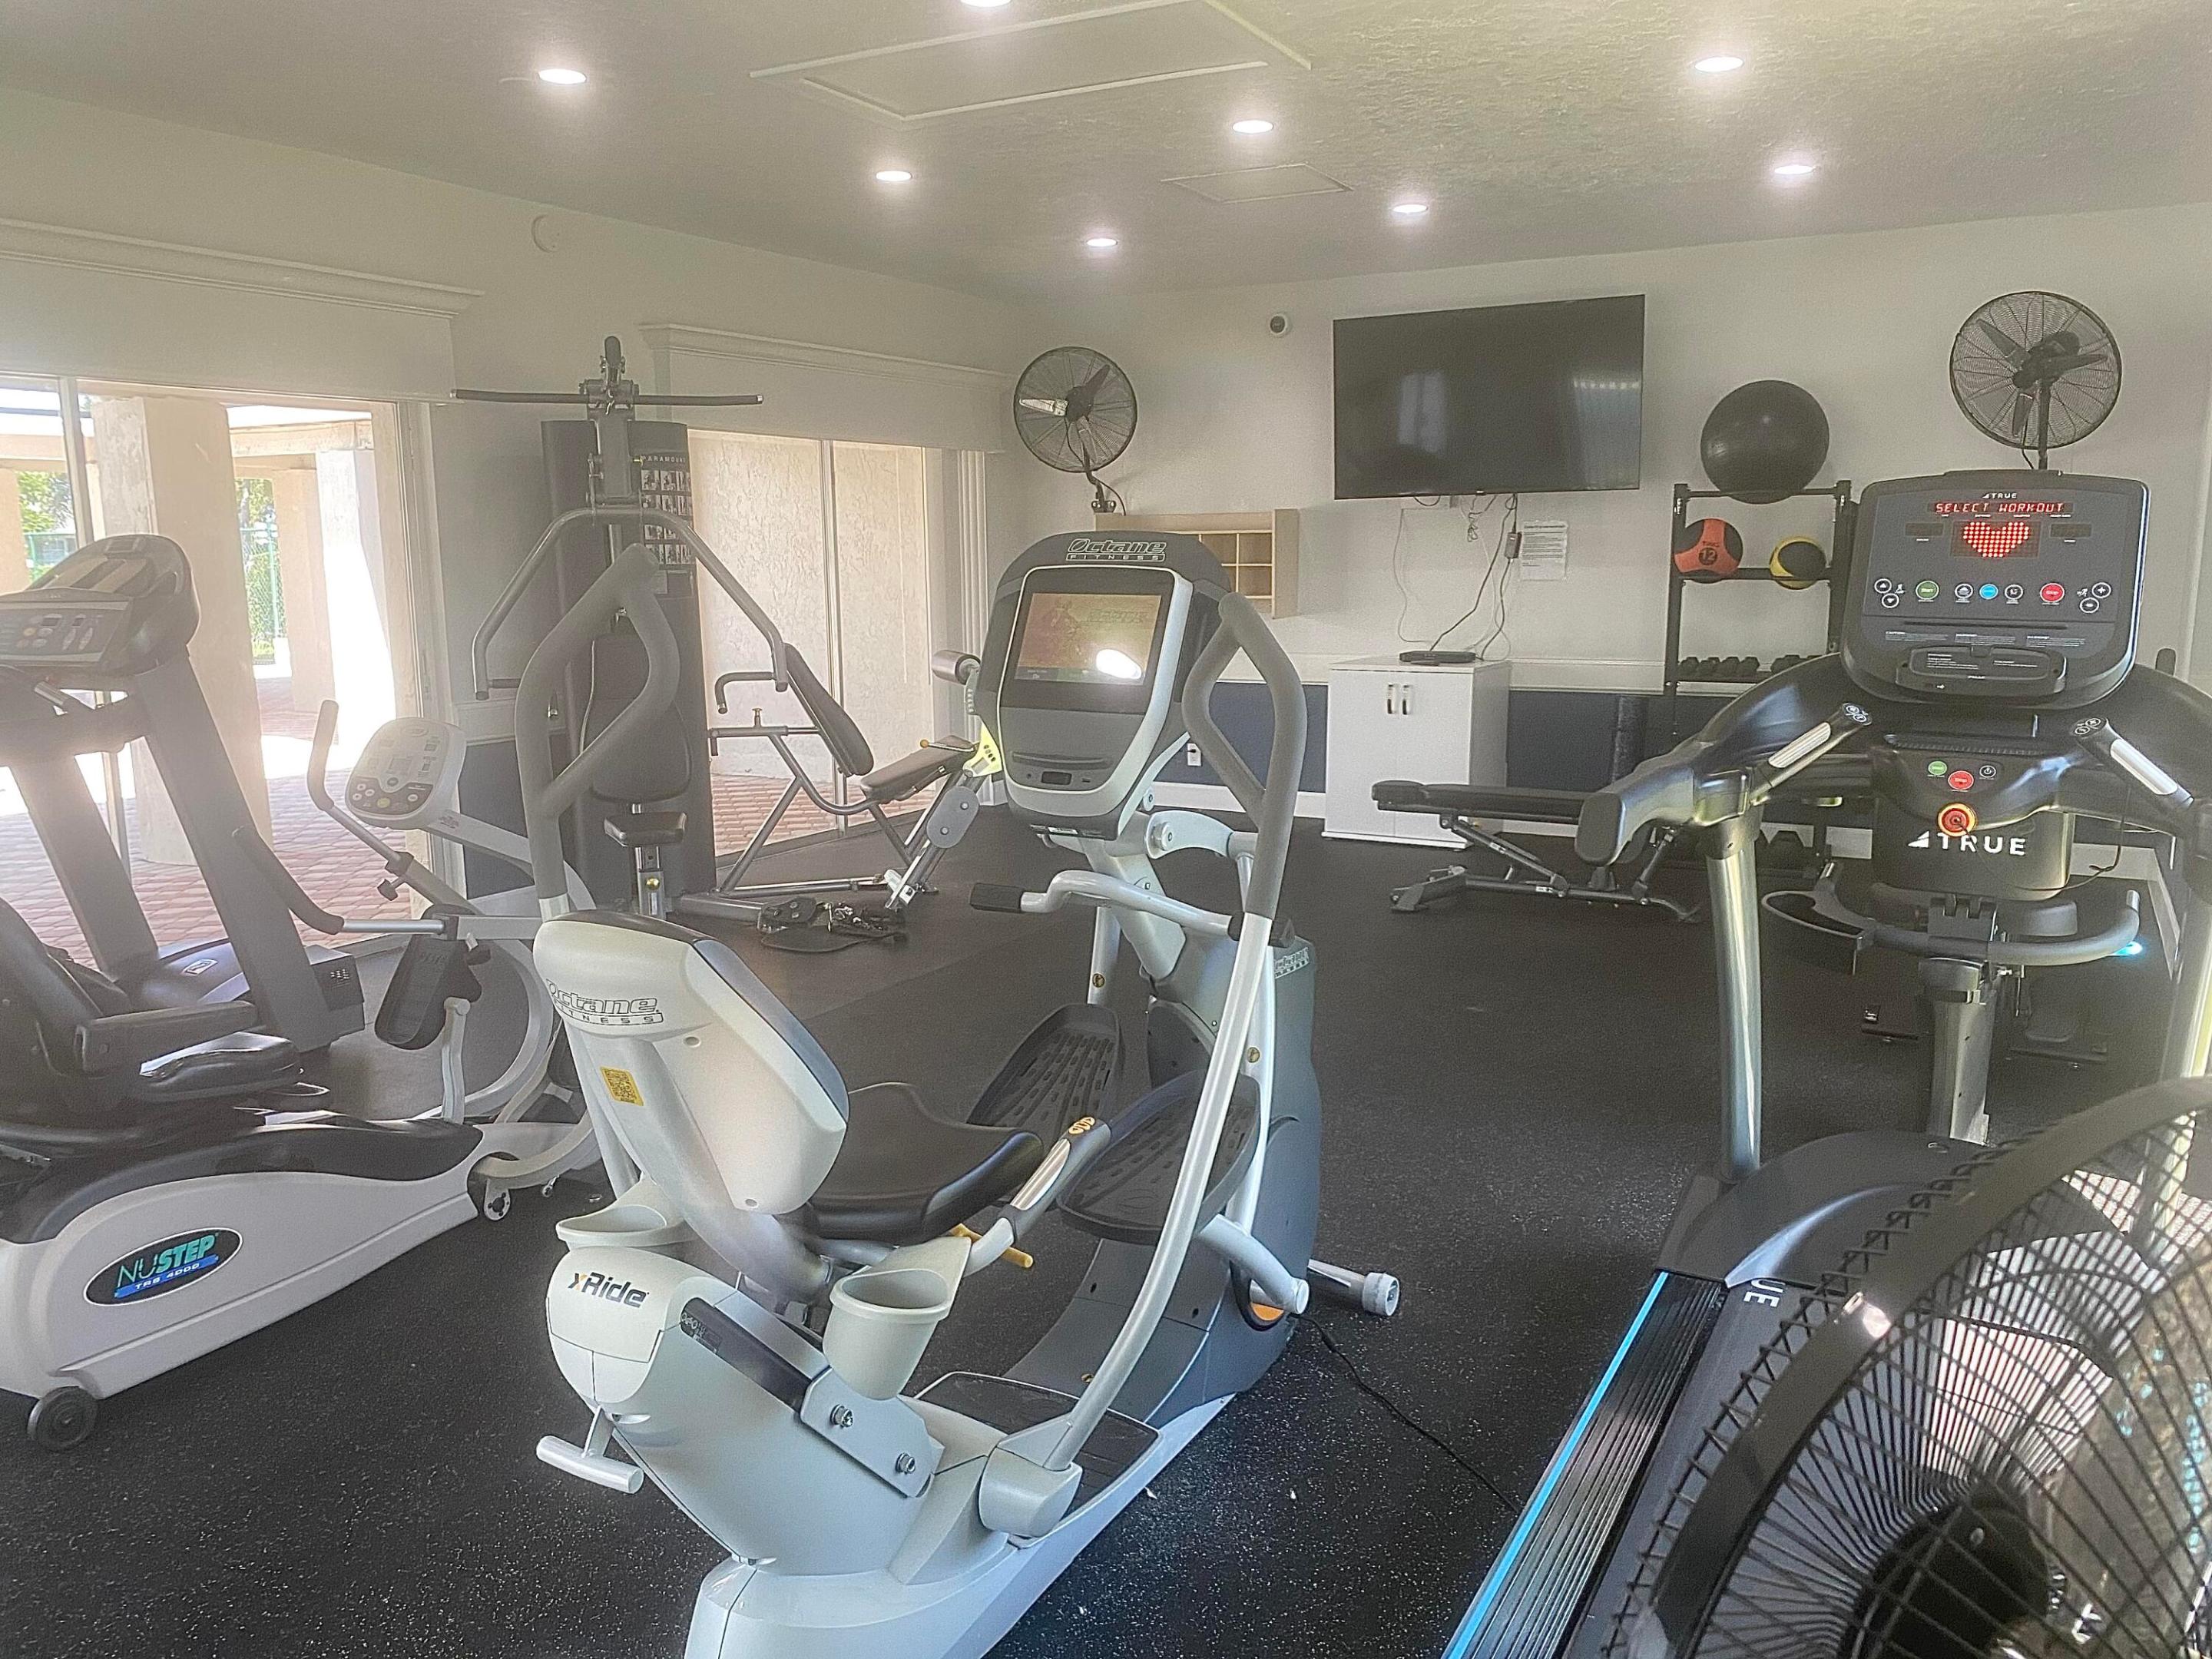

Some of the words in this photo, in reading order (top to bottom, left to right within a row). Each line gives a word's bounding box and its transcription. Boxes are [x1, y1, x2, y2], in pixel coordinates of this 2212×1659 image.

[1936, 502, 1989, 512] SELECT
[1998, 502, 2064, 512] WORKOUT
[1068, 538, 1167, 553] Octane
[1701, 549, 1716, 561] 12
[1937, 832, 2026, 856] TRUE
[545, 979, 658, 1014] Octane
[167, 1263, 200, 1279] 4000
[568, 1272, 647, 1308] xRide
[1743, 1279, 1786, 1307] UE
